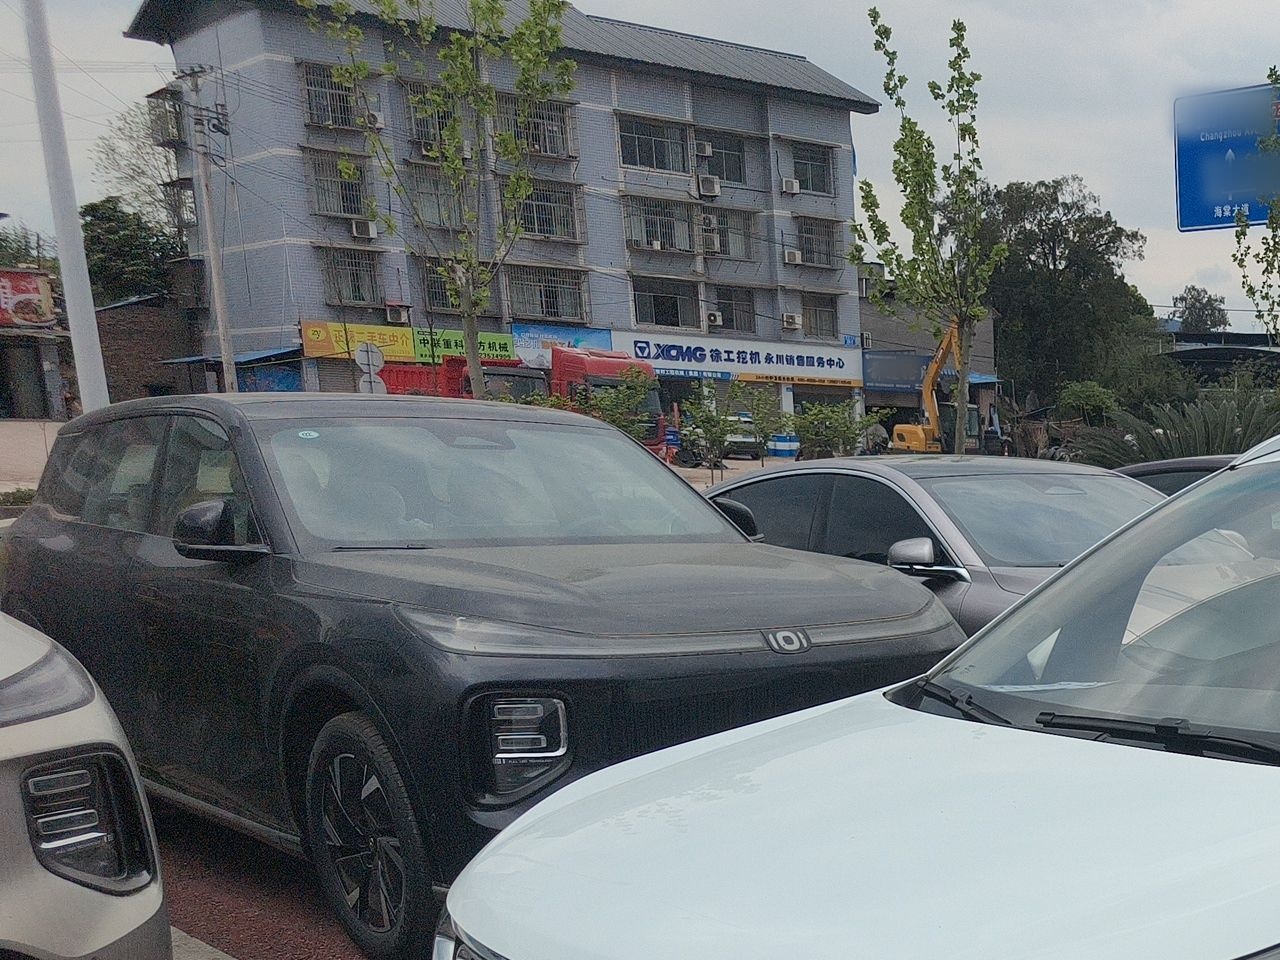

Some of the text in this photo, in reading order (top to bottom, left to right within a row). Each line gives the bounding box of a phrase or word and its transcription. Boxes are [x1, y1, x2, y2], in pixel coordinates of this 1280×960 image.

[1200, 129, 1241, 142] Changzhou
[1213, 203, 1250, 219] 海棠大道
[419, 336, 509, 353] 中联重科方机械
[652, 343, 707, 363] XCMG
[709, 346, 845, 369] 徐工挖机 永川销售服务中心
